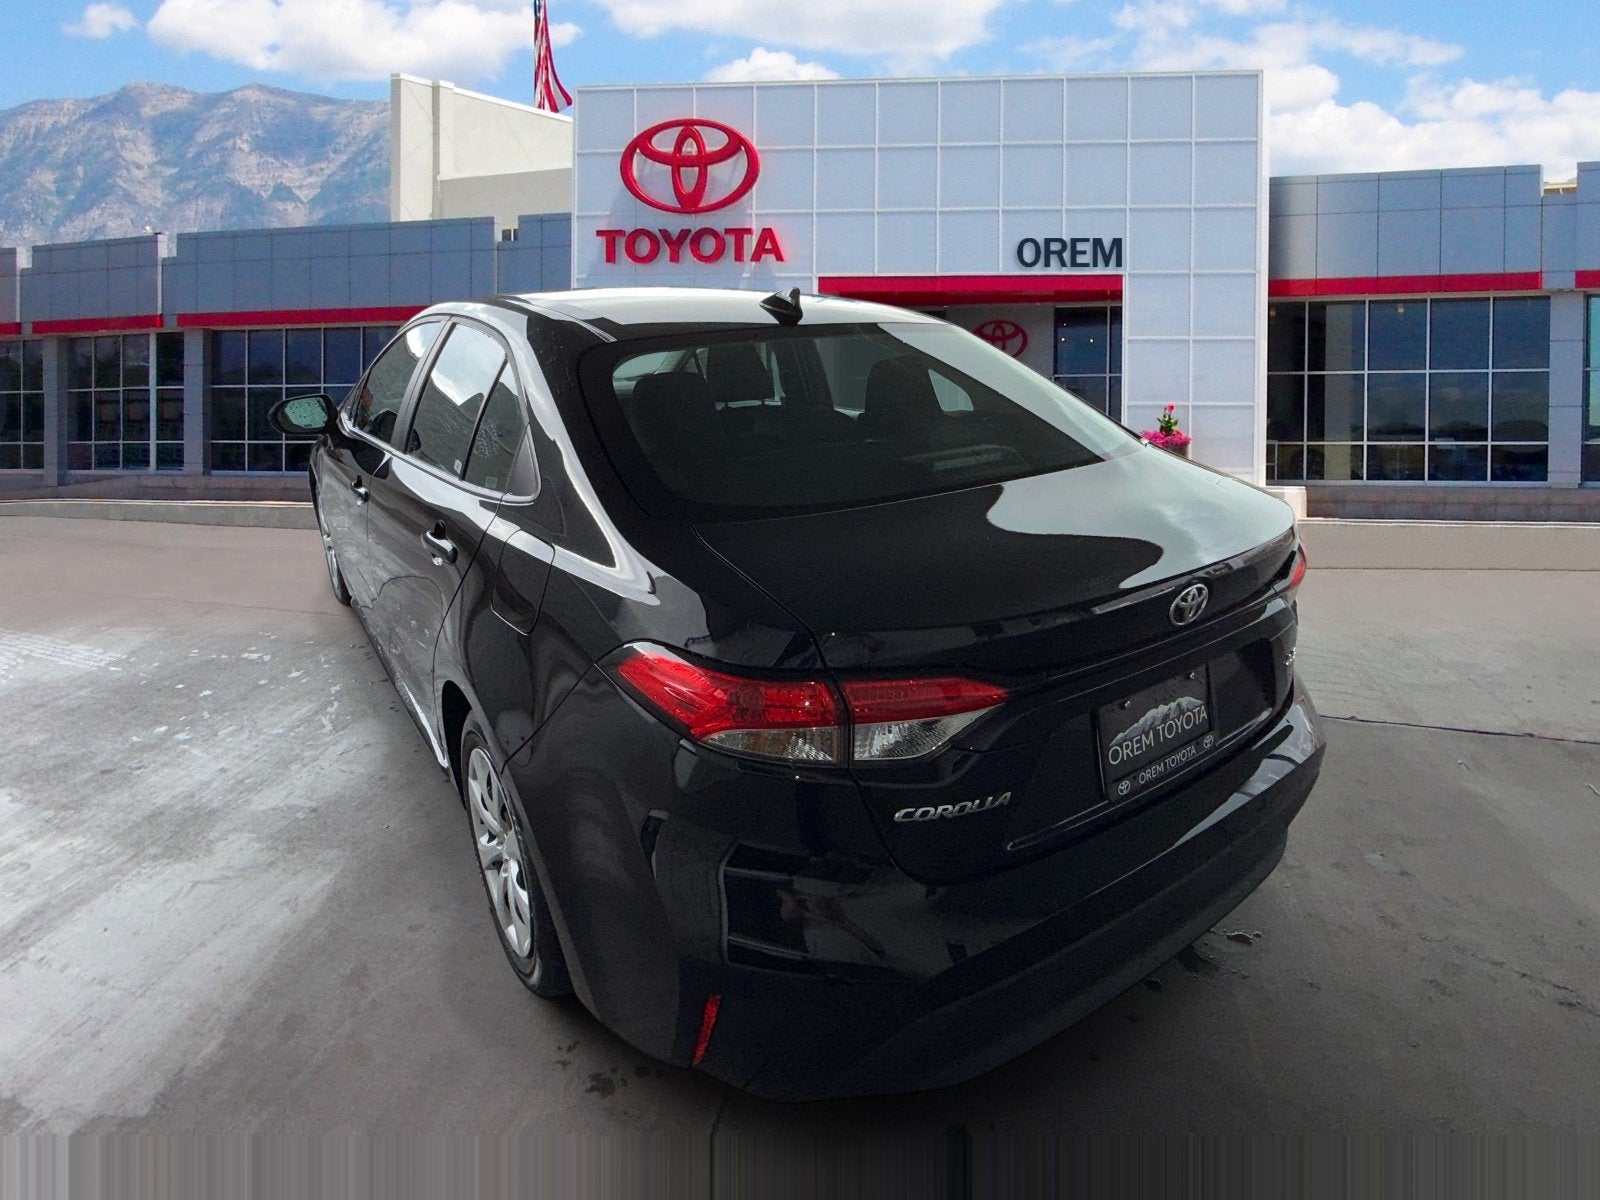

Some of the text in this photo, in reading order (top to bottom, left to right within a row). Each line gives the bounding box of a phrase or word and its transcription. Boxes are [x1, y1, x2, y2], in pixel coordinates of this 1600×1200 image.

[596, 227, 785, 264] TOYOTA
[1016, 237, 1123, 269] OREM
[1108, 704, 1208, 765] OREM TOYOTA
[1138, 745, 1197, 785] OREM TOYOTA
[893, 791, 1012, 823] COROLLA
